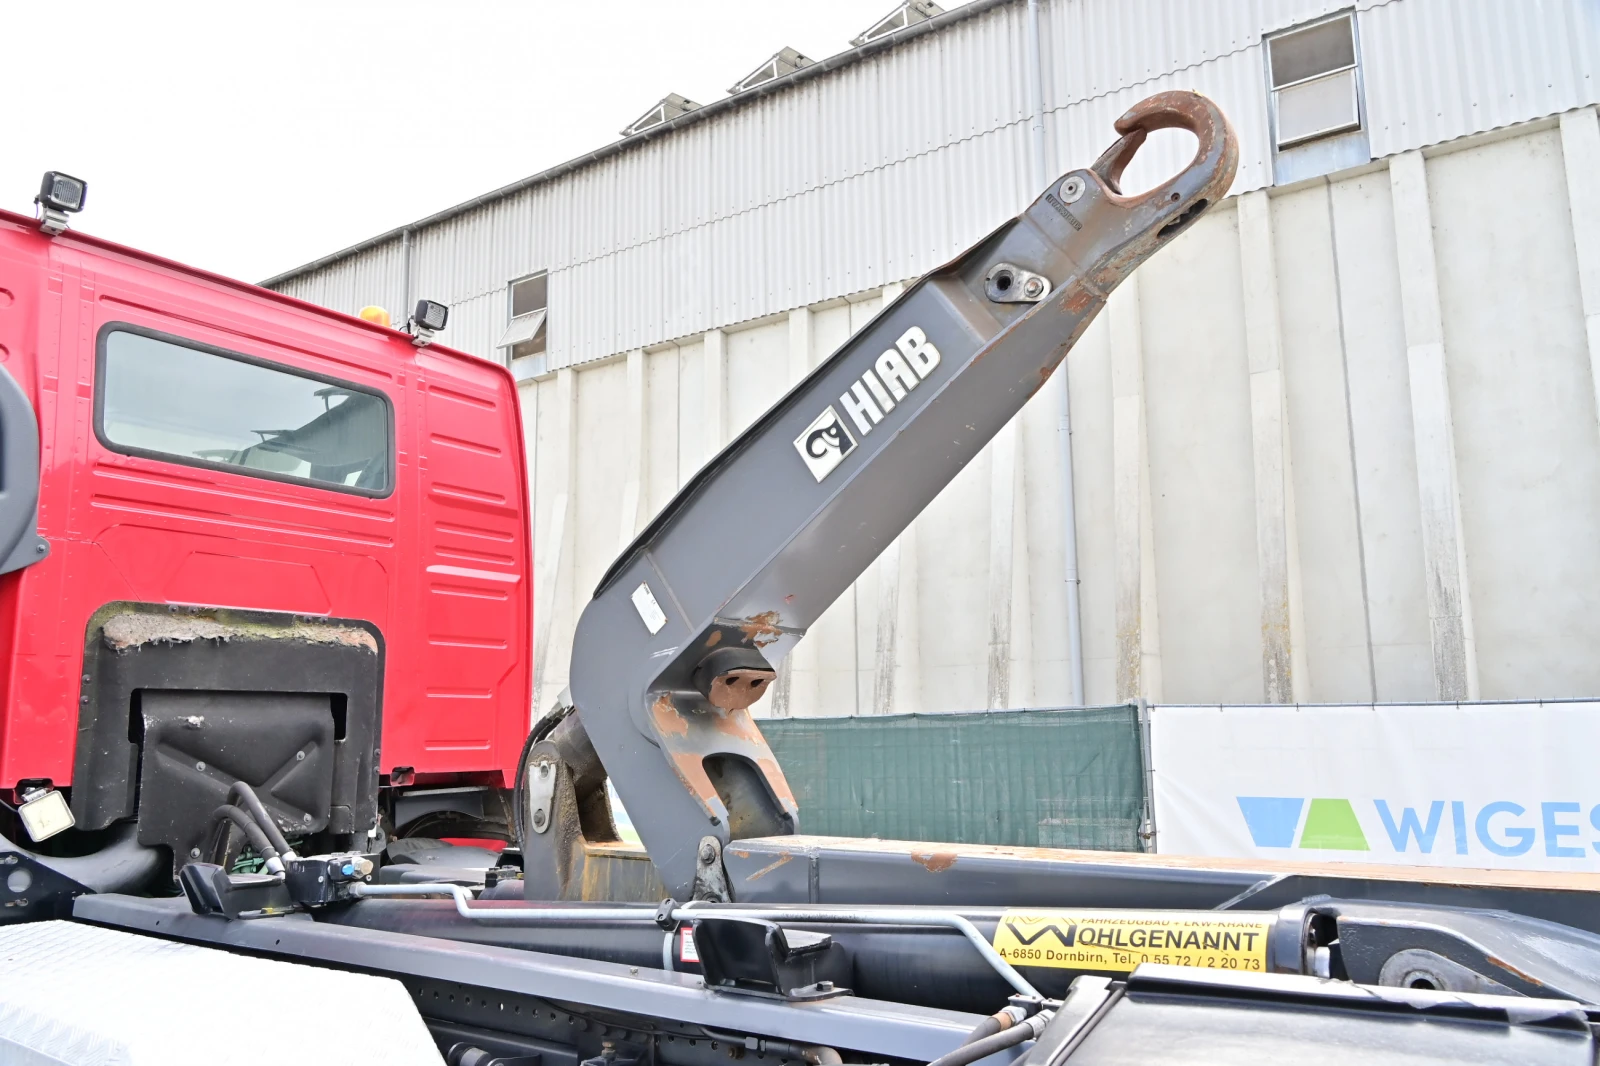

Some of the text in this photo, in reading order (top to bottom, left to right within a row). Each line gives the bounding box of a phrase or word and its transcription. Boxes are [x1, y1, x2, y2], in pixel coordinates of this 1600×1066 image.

[839, 326, 941, 437] HIAB
[999, 948, 1261, 971] A-6850 Dornbirn, Tel. 0 55 72 / 2 20 73
